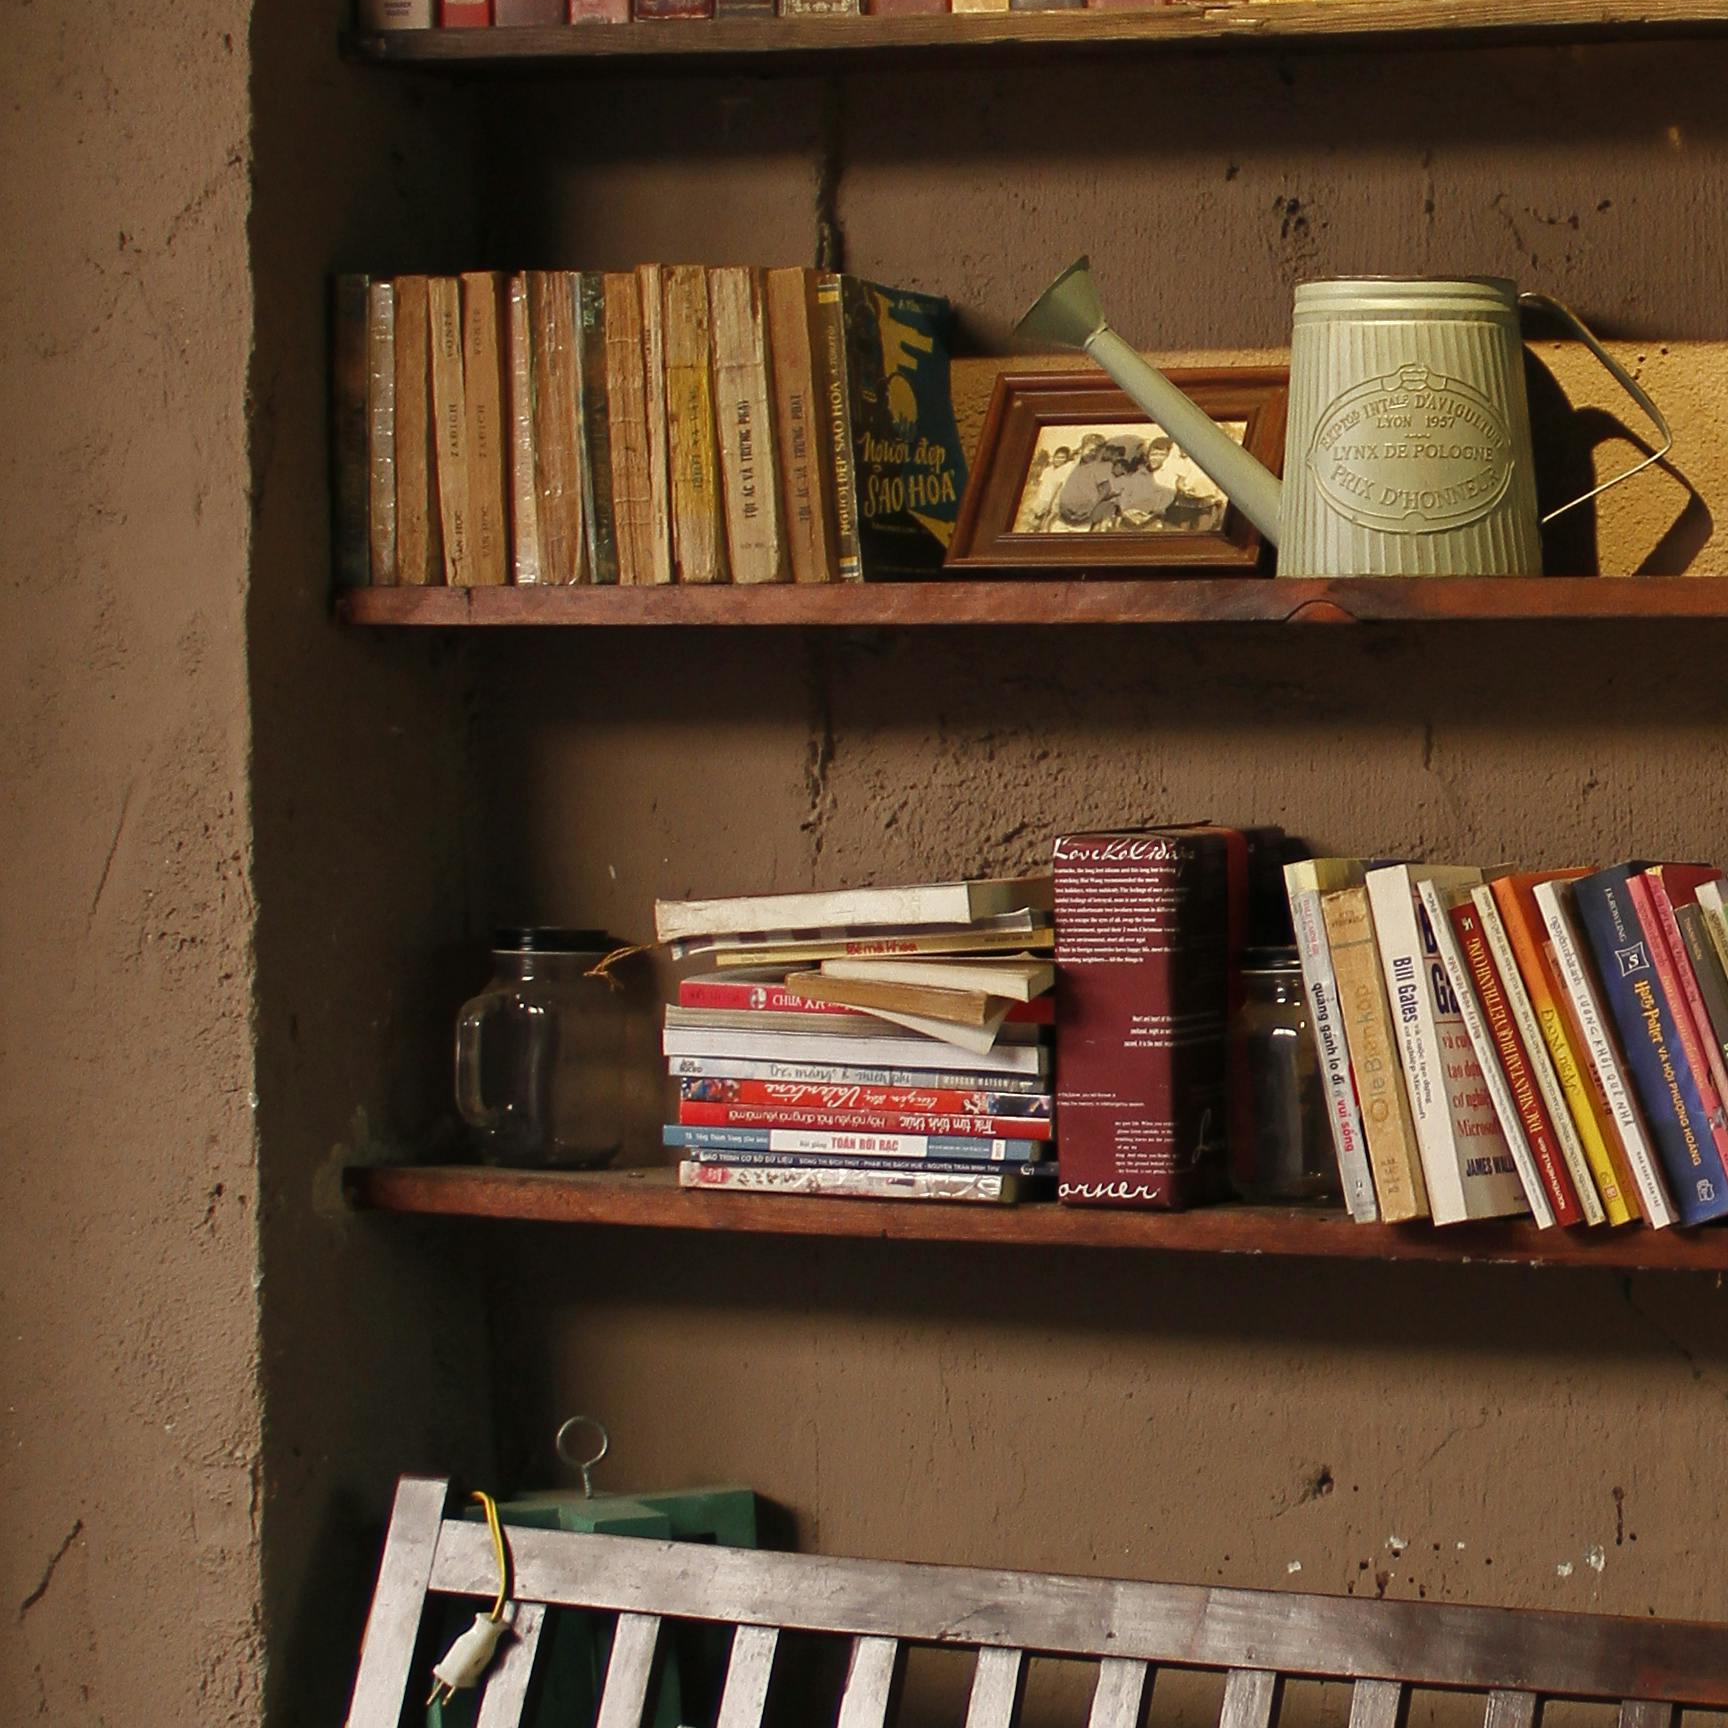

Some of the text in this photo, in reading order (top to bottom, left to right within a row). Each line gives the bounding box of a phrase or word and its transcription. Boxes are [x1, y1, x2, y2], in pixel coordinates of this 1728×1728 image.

[830, 419, 848, 452] SAO
[1377, 414, 1457, 429] LYON 1957
[1332, 442, 1494, 462] LYNX DE POLOGNE
[864, 474, 904, 519] SAO
[1329, 464, 1376, 500] PRIX
[1628, 954, 1639, 969] 5
[1392, 956, 1419, 1024] Bill Gates
[1318, 1022, 1338, 1055] gánh
[1327, 1055, 1339, 1070] lo
[764, 1083, 863, 1108] Valentine
[1605, 1073, 1622, 1104] QUÊ
[1616, 1105, 1636, 1128] NHÀ
[1658, 1047, 1668, 1063] VÀ
[1684, 1125, 1702, 1166] HOÀNG
[831, 1135, 856, 1149] TOÁN
[1337, 1099, 1354, 1153] vui sống
[1466, 1156, 1492, 1177] JAMES
